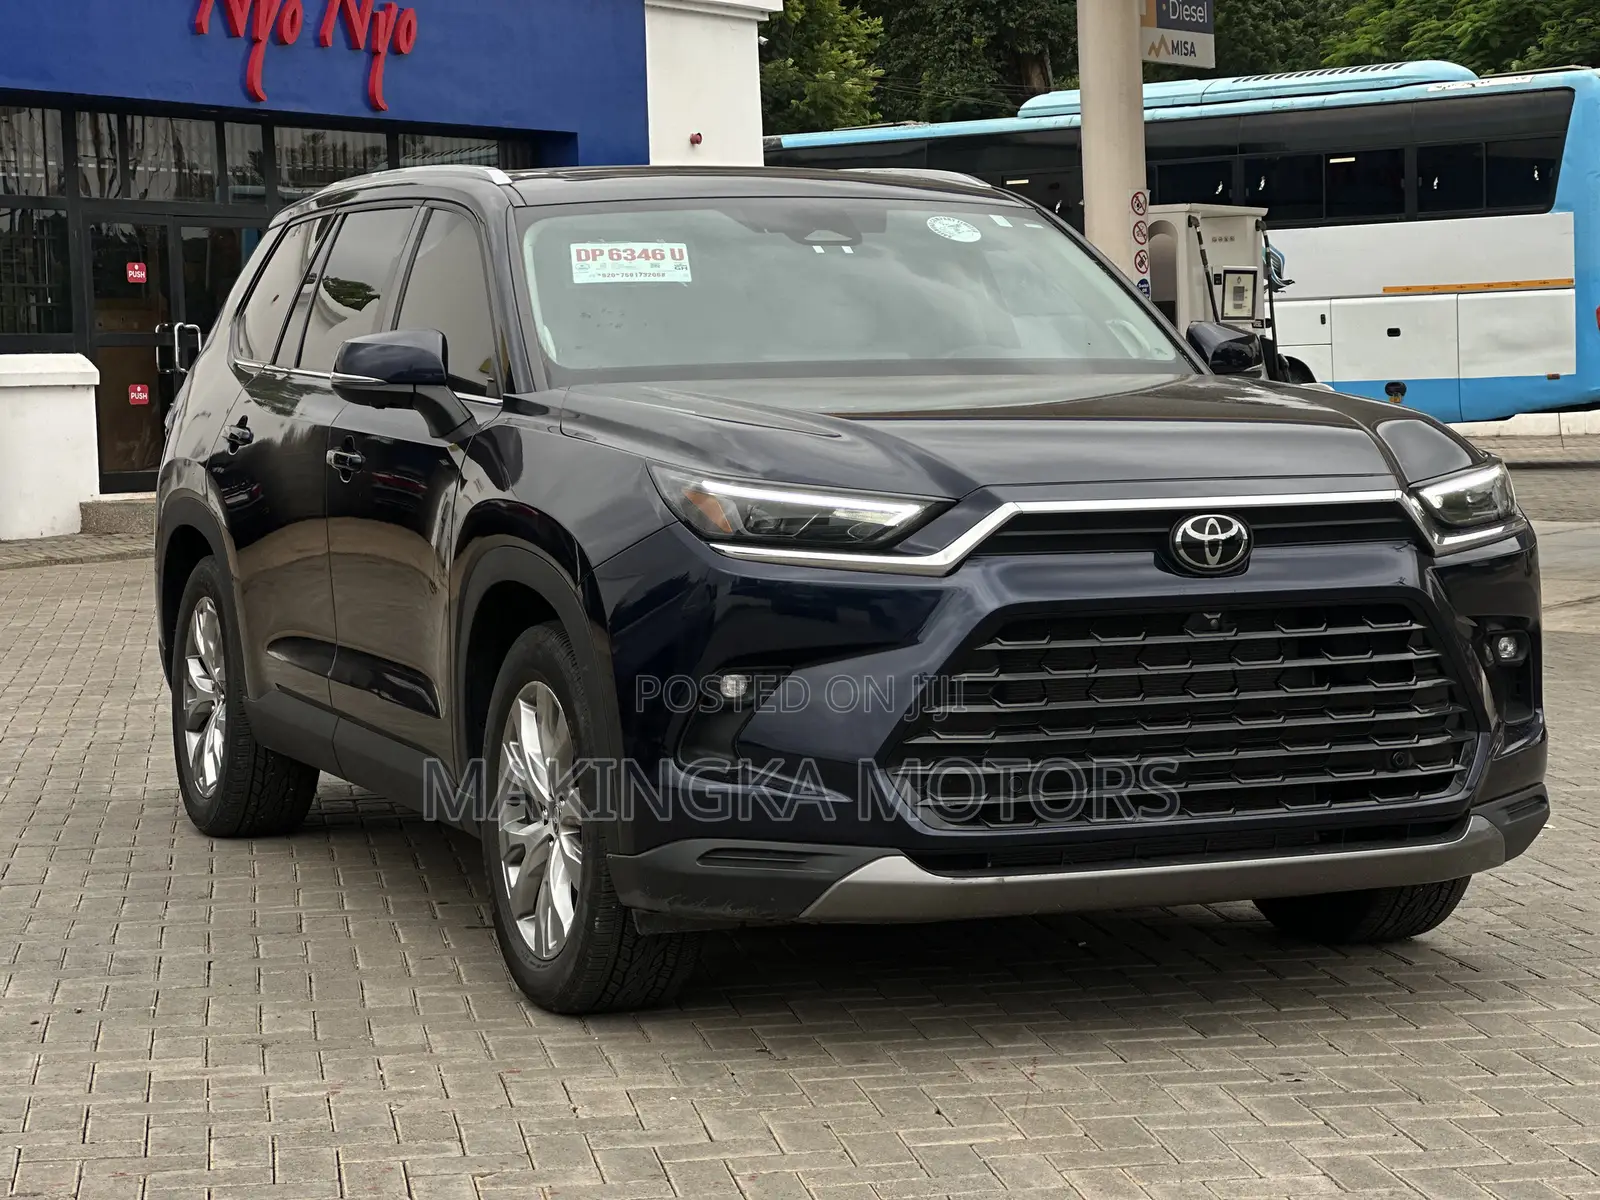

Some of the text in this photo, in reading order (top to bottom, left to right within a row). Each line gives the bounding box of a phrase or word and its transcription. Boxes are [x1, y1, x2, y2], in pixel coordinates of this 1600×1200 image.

[1169, 0, 1208, 24] Diesel
[319, 0, 418, 111] Nyo
[1171, 39, 1197, 58] MISA
[575, 247, 685, 262] DP 6346 U
[128, 270, 146, 279] PUSH
[130, 392, 148, 400] PUSH
